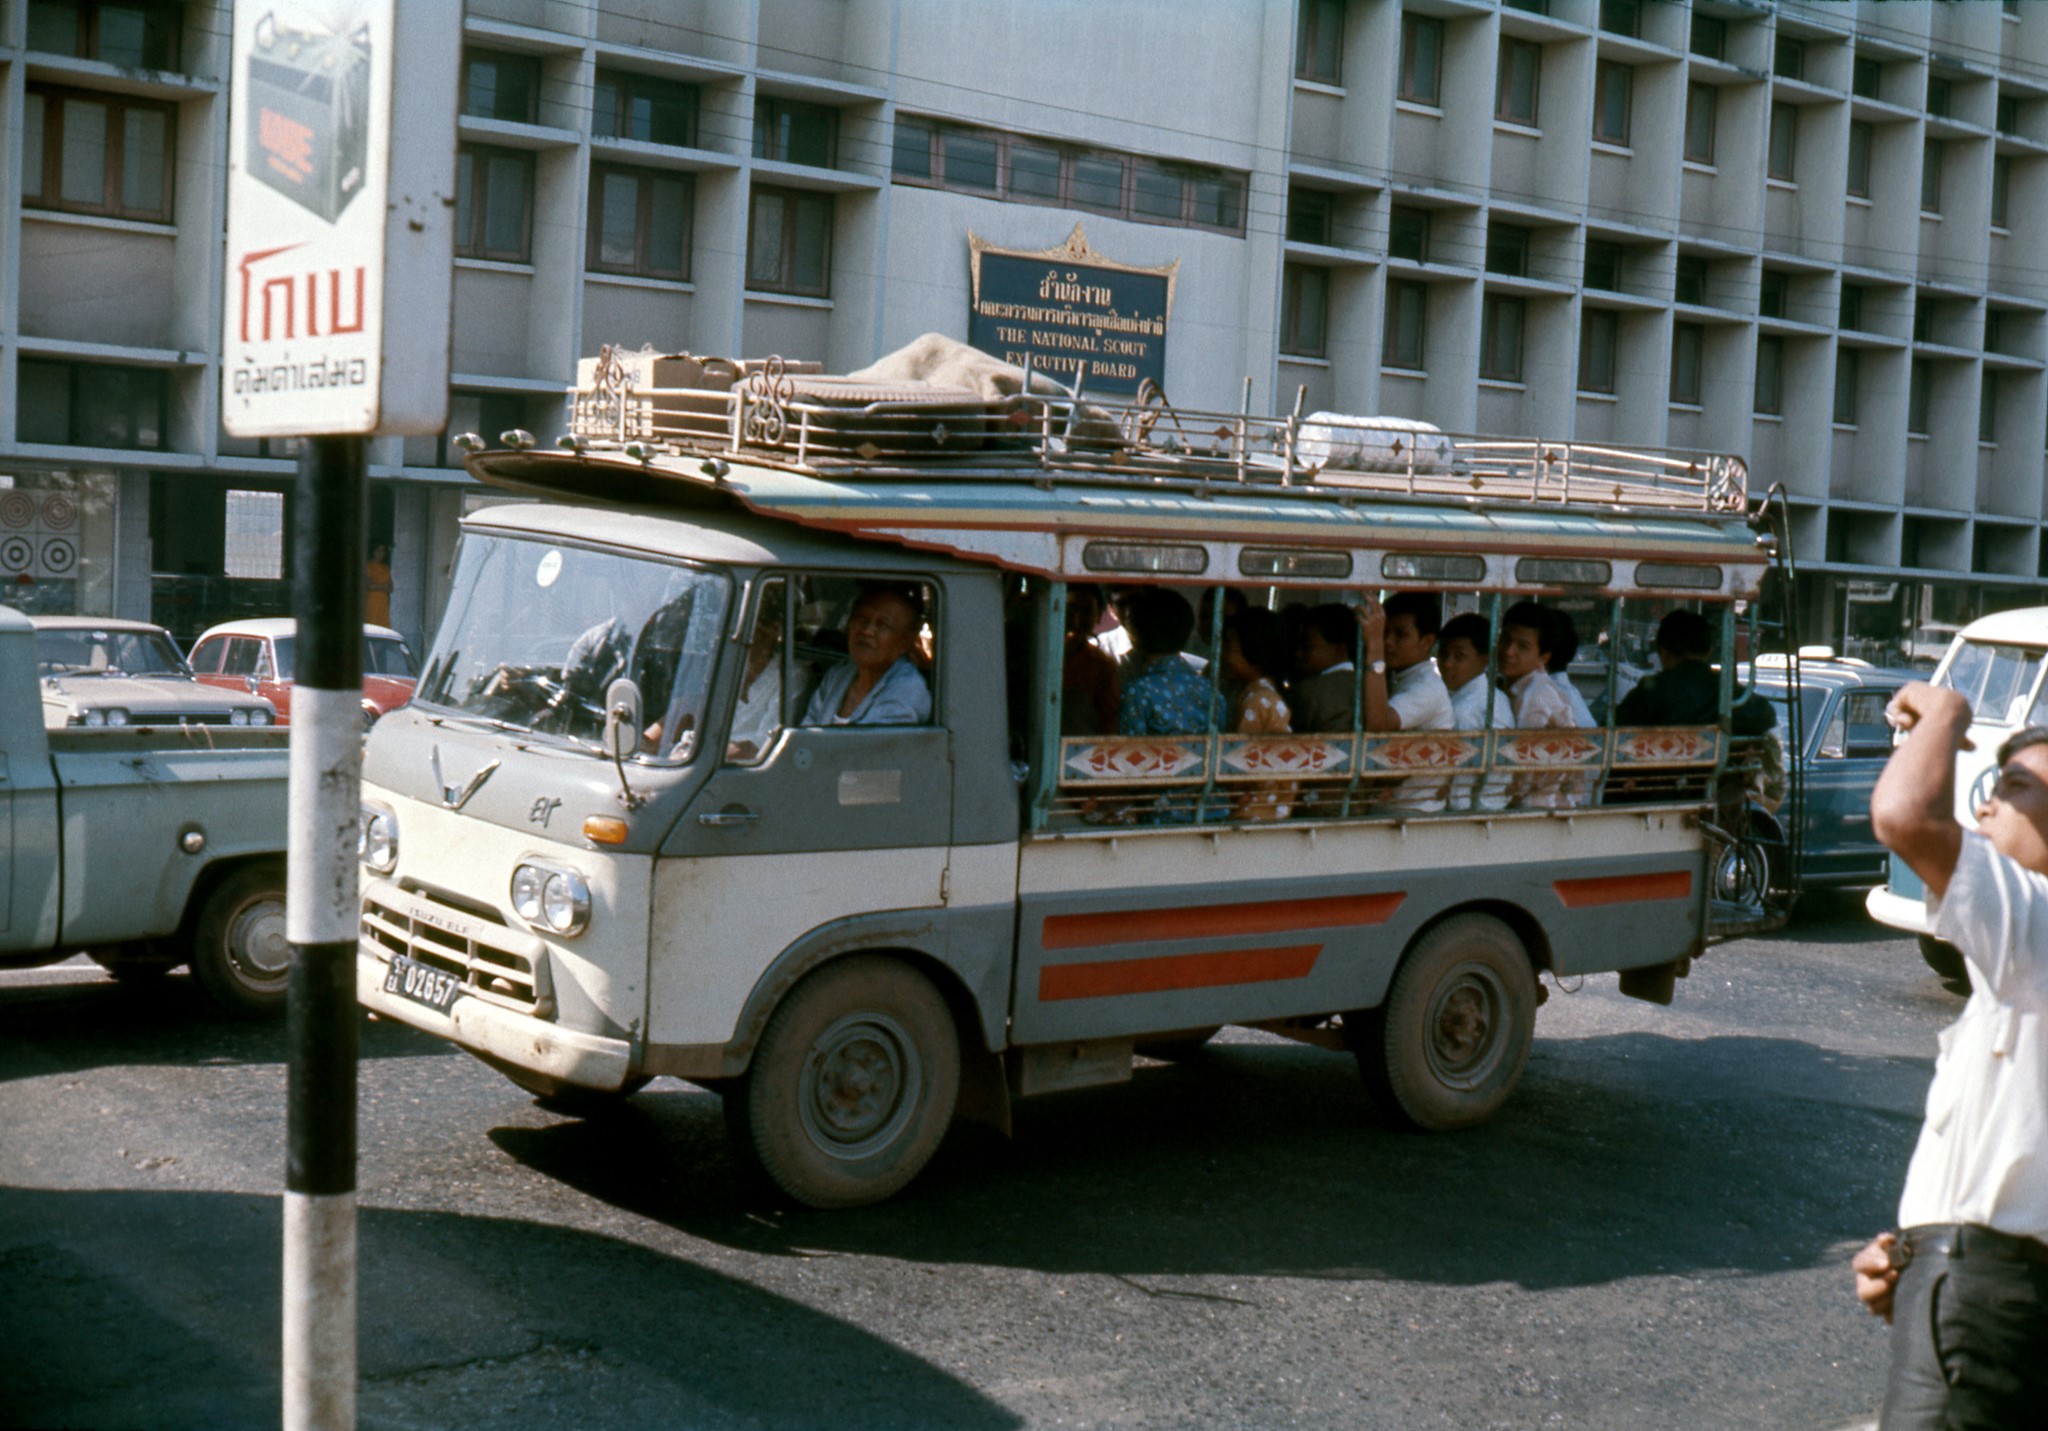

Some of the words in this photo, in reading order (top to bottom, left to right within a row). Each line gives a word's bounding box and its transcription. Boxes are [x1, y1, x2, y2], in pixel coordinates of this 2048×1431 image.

[1039, 270, 1112, 306] สำนักงาน
[997, 326, 1026, 344] THE
[1031, 330, 1099, 352] NATIONAL
[1103, 338, 1147, 357] SCOUT
[1006, 351, 1088, 373] EXCUTIV
[1092, 360, 1137, 379] BOARD
[404, 965, 456, 1007] 02657
